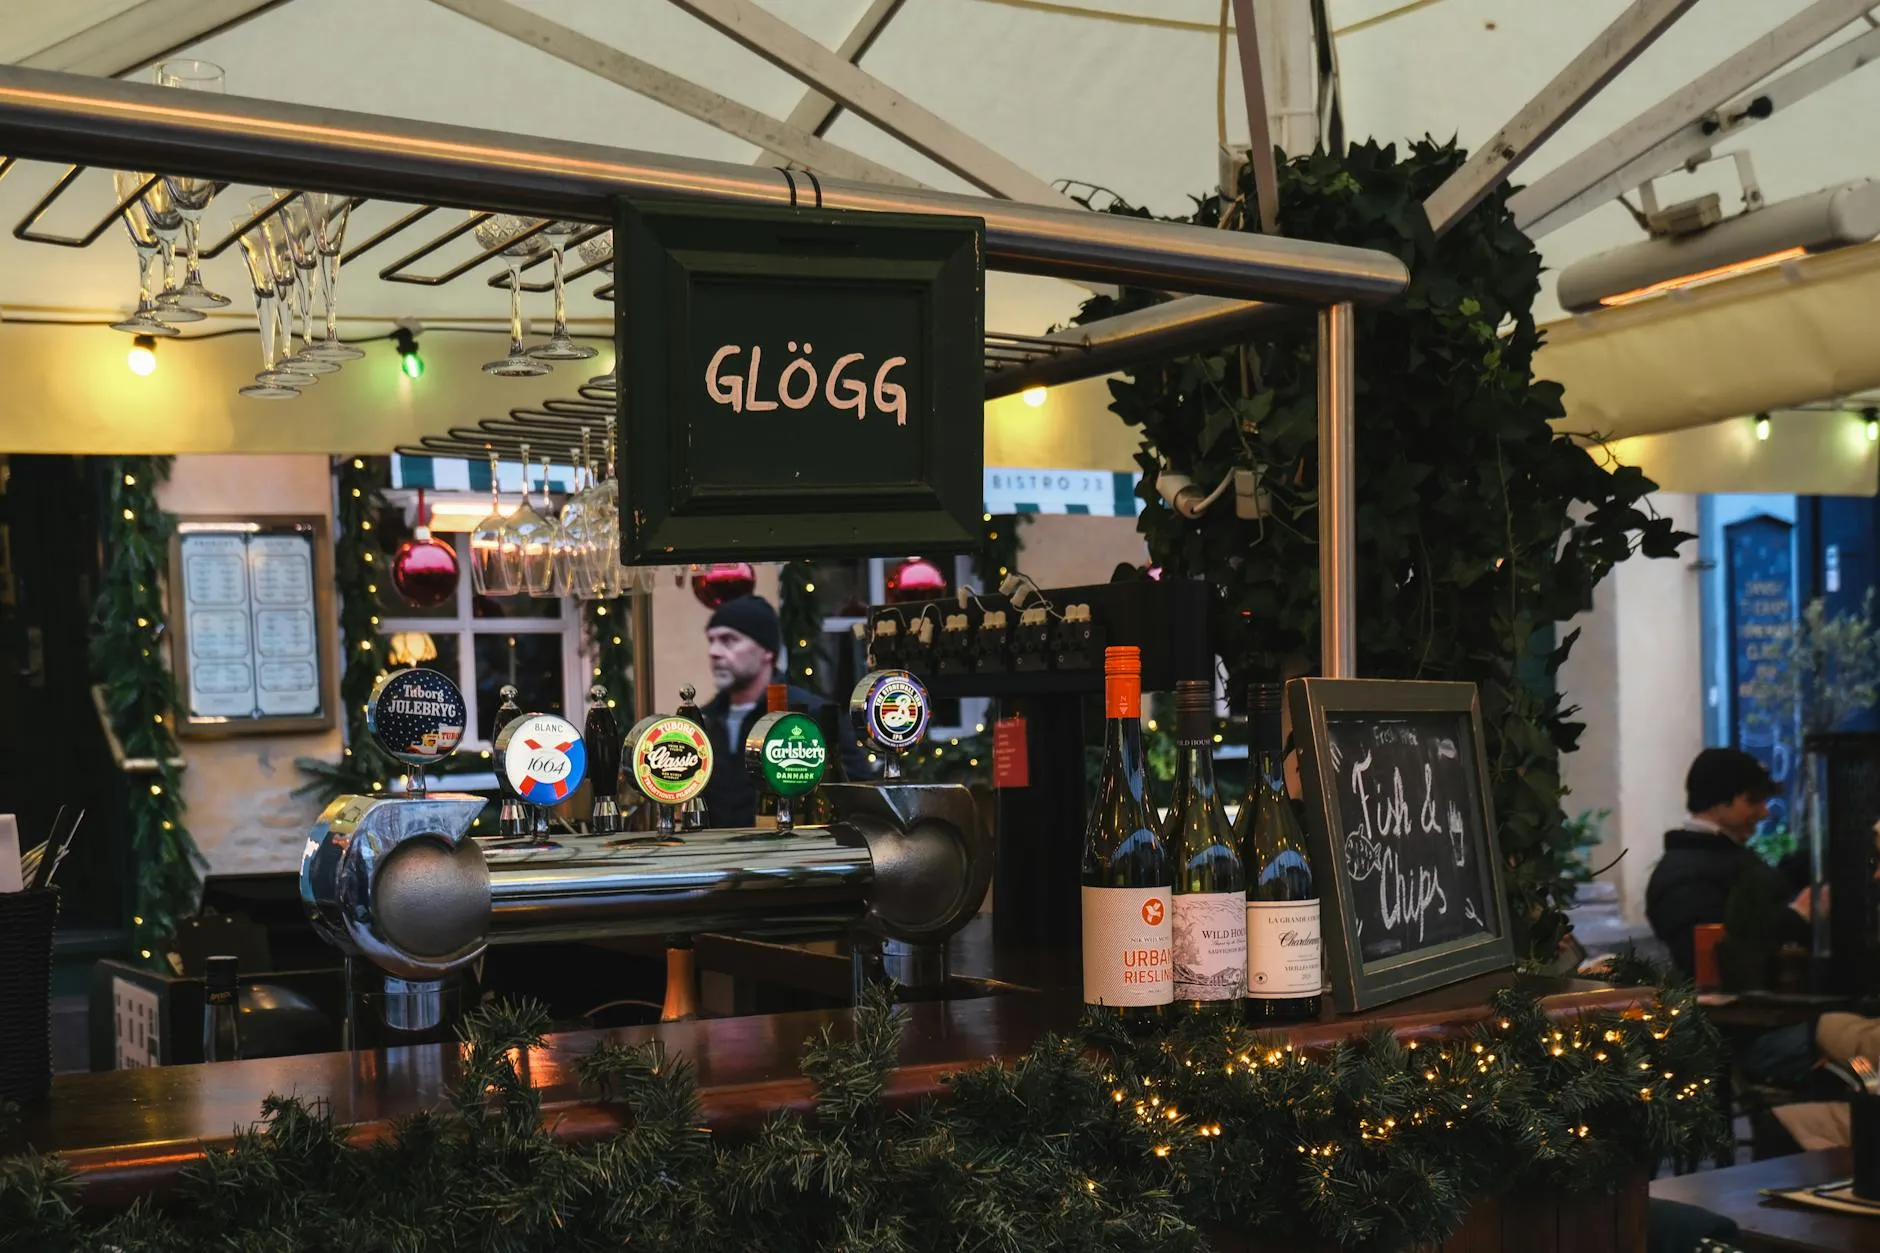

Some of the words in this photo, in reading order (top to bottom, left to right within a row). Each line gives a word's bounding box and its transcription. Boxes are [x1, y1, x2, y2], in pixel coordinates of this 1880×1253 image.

[705, 341, 906, 426] GLÖGG
[992, 475, 1070, 491] BISTRO
[403, 683, 444, 702] Tuborg
[388, 700, 457, 718] JULEBRYG
[534, 722, 565, 733] BLANC
[656, 721, 696, 737] TUBORG
[892, 733, 904, 741] IPA
[647, 745, 699, 770] Classic
[765, 738, 826, 764] Carlsberg
[527, 756, 566, 775] 1664
[776, 772, 815, 780] DANMARK
[1352, 747, 1413, 840] Fish
[1379, 845, 1447, 943] Chips
[1202, 930, 1230, 940] WILD
